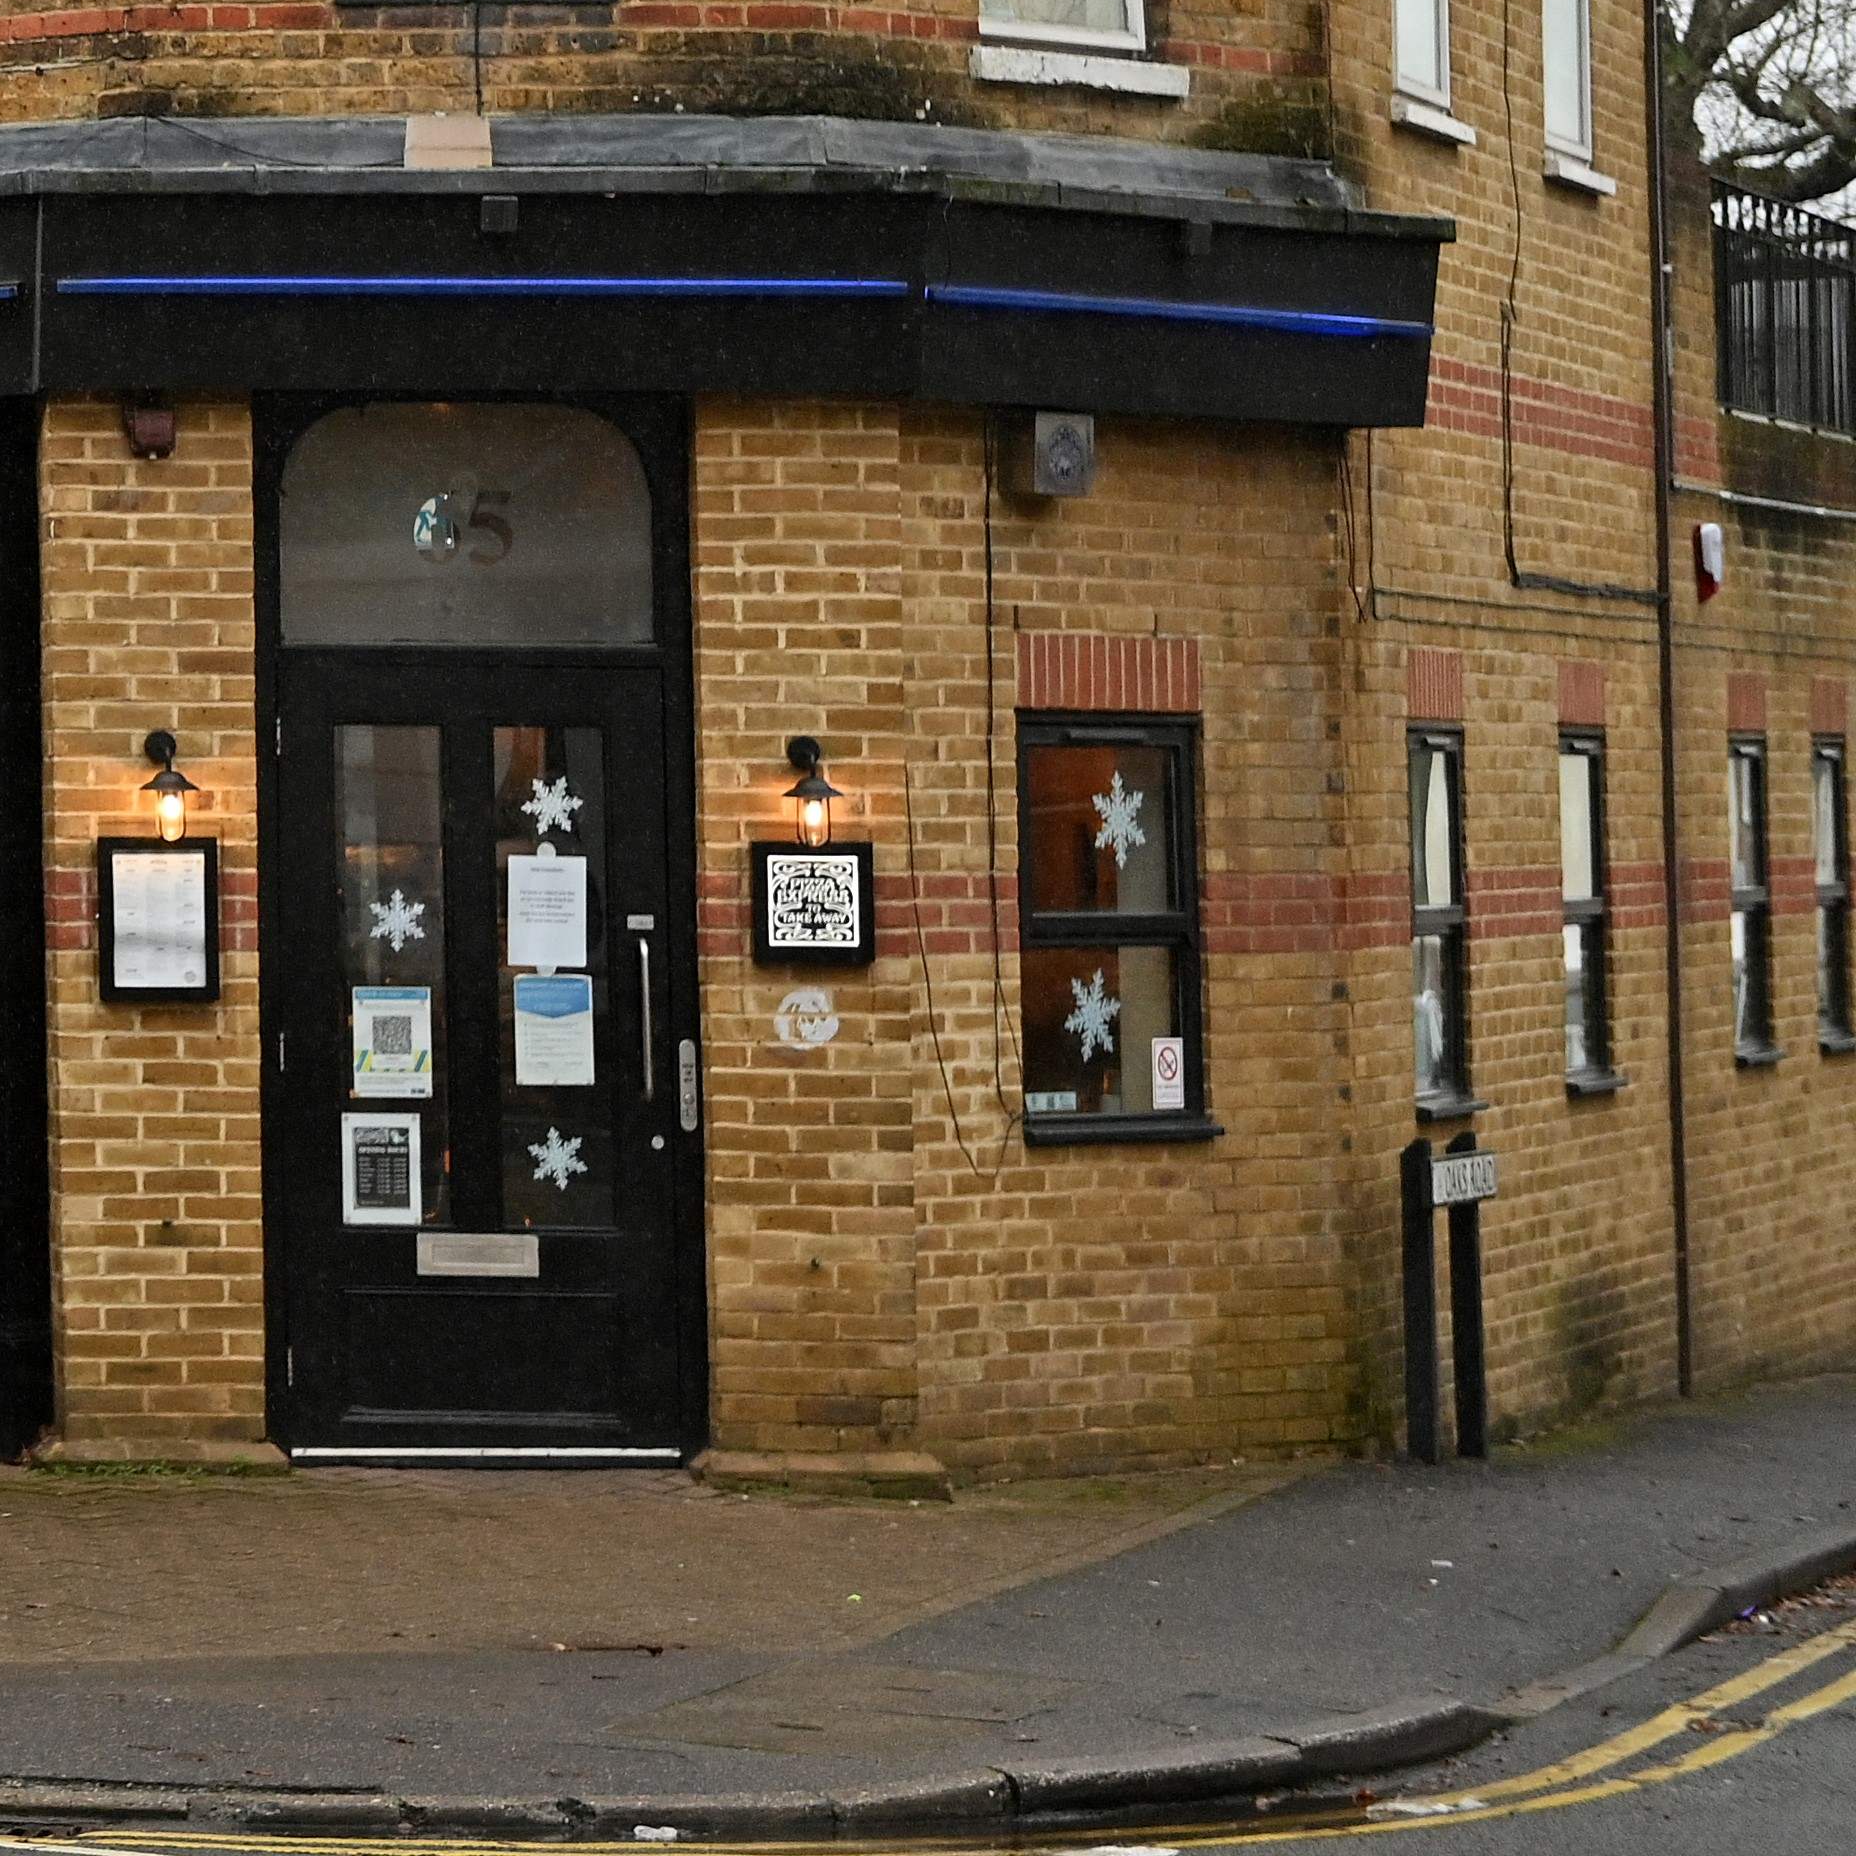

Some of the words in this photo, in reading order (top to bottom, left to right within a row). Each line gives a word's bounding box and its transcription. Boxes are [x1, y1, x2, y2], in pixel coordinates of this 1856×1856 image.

[790, 878, 836, 893] PIZZA
[806, 904, 821, 913] TO
[779, 912, 812, 924] TAKE
[814, 912, 847, 924] AWAY
